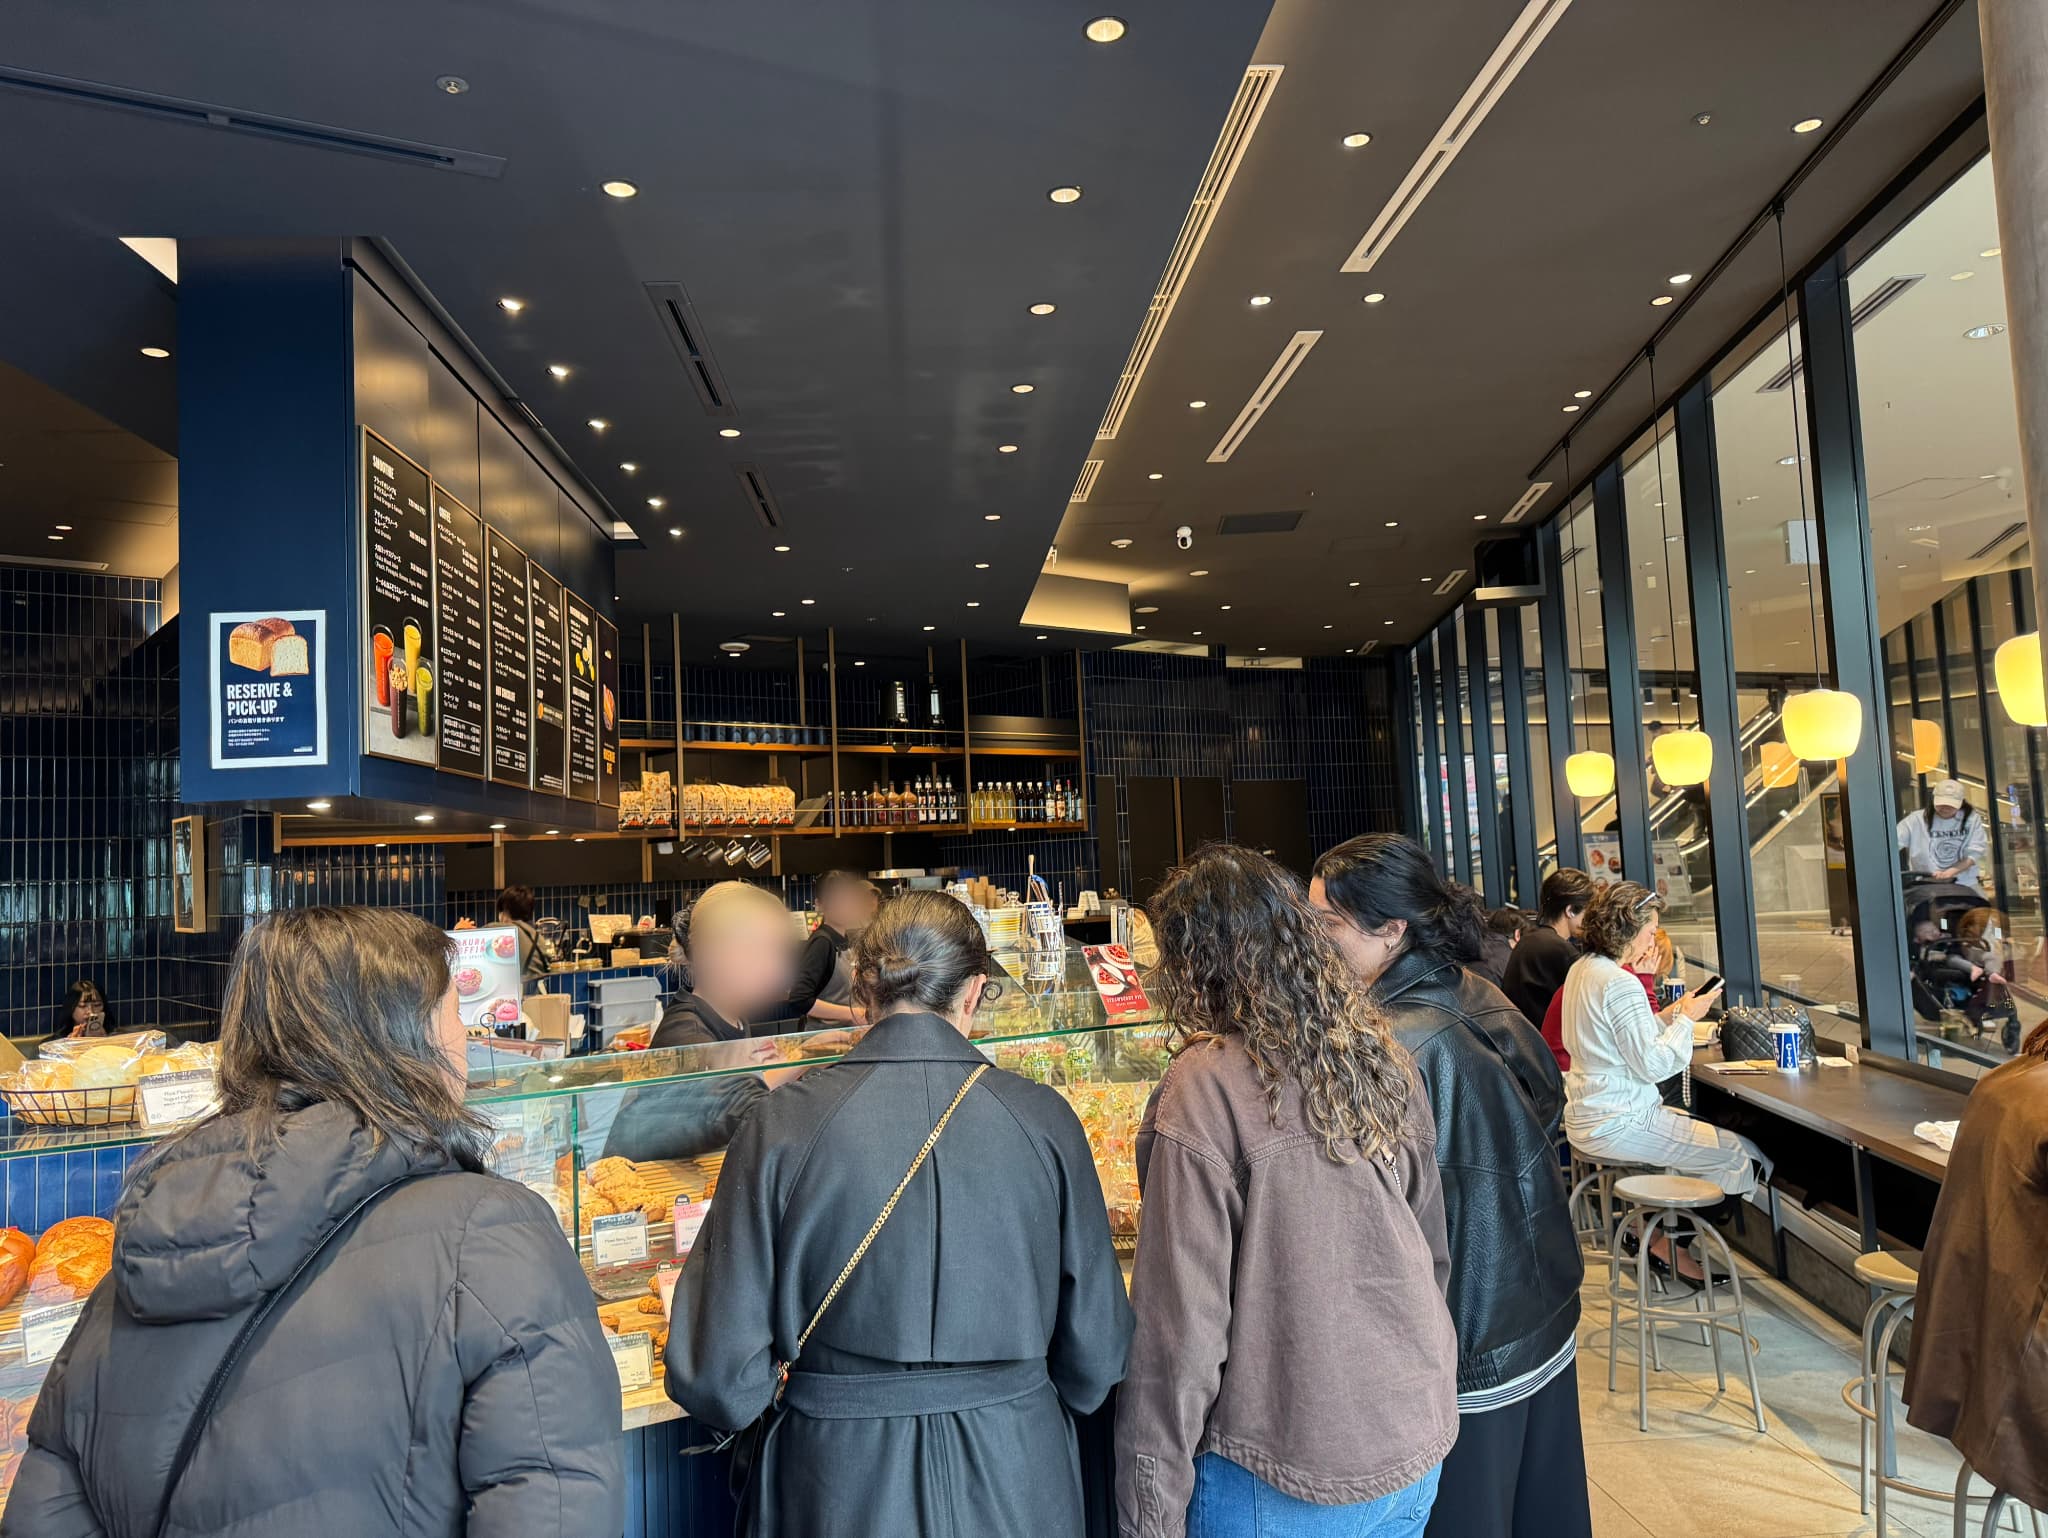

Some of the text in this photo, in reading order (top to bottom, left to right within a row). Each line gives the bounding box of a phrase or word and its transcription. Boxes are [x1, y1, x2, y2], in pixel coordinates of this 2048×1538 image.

[227, 682, 292, 700] RESERVE &
[228, 700, 277, 716] PICK-UP
